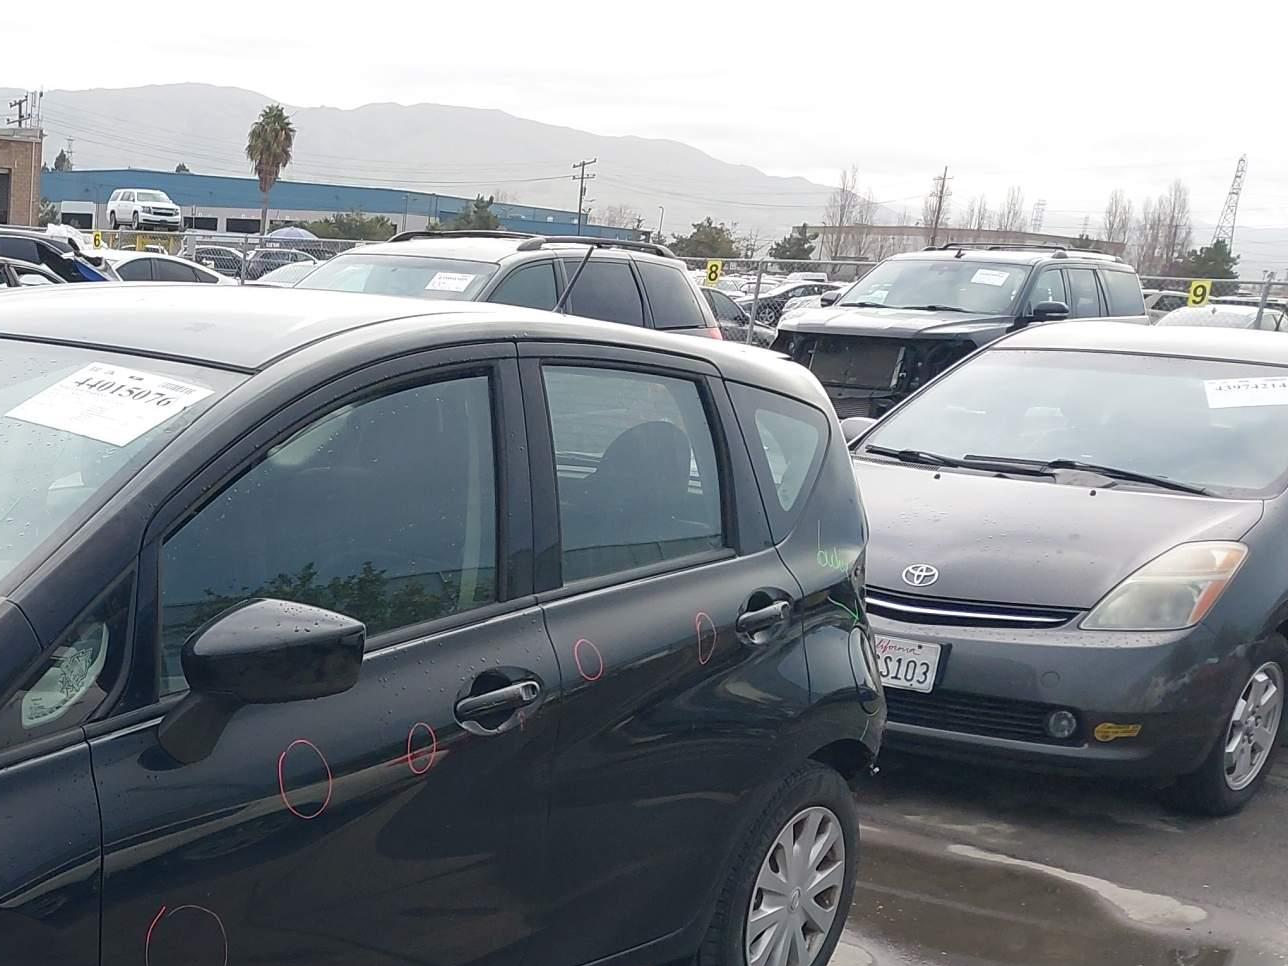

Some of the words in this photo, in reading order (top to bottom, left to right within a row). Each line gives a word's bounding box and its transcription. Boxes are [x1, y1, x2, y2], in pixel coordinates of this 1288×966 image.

[93, 233, 101, 248] 6
[708, 264, 719, 281] 8
[1192, 284, 1207, 305] 9
[74, 376, 173, 407] 44015076
[876, 654, 930, 684] S103
